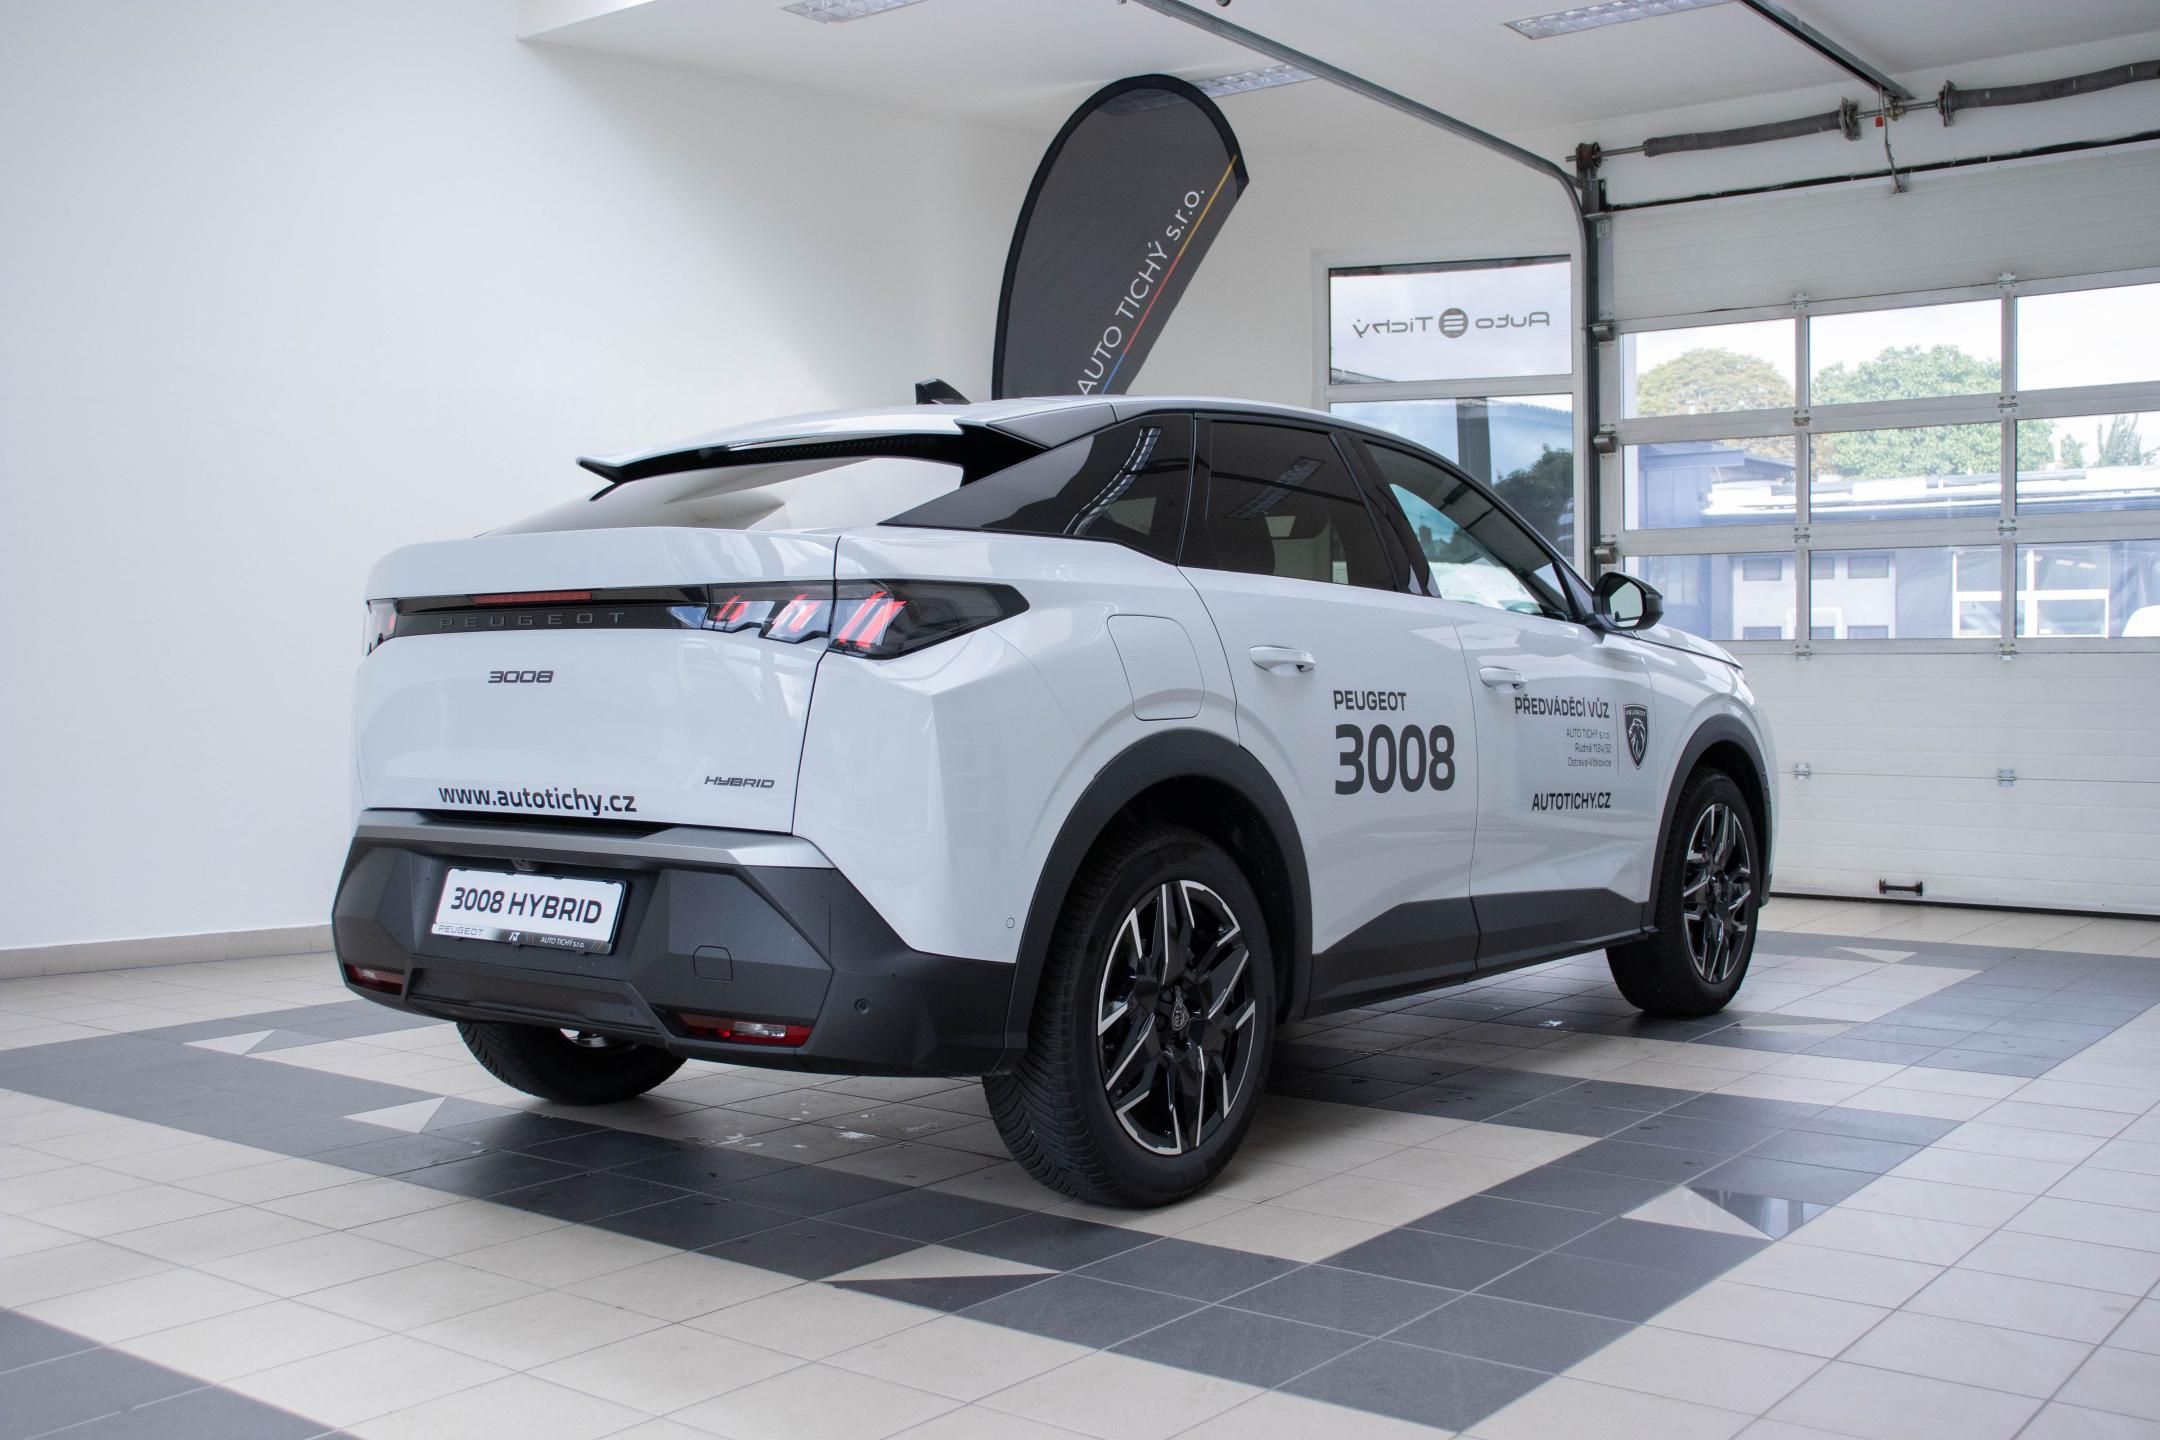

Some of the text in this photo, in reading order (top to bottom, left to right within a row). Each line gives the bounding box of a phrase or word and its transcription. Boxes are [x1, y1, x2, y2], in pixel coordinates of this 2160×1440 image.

[1077, 189, 1205, 395] AUTO TICHÝ s.r.o.
[439, 612, 625, 629] PEUGEOT
[487, 670, 554, 684] 3008
[1333, 690, 1407, 711] PEUGEOT
[1514, 694, 1610, 719] PŘEDVÁDĚCÍ VŮZ
[1566, 728, 1582, 739] AUTO
[1334, 723, 1456, 795] 3008
[704, 775, 775, 789] HYBRID
[439, 787, 638, 816] www.autotichy.cz
[1531, 792, 1611, 811] AUTOTICHY.CZ
[451, 887, 603, 924] 3008 HYBRID
[438, 924, 484, 936] PEUGEOT
[540, 936, 557, 945] AUTO
